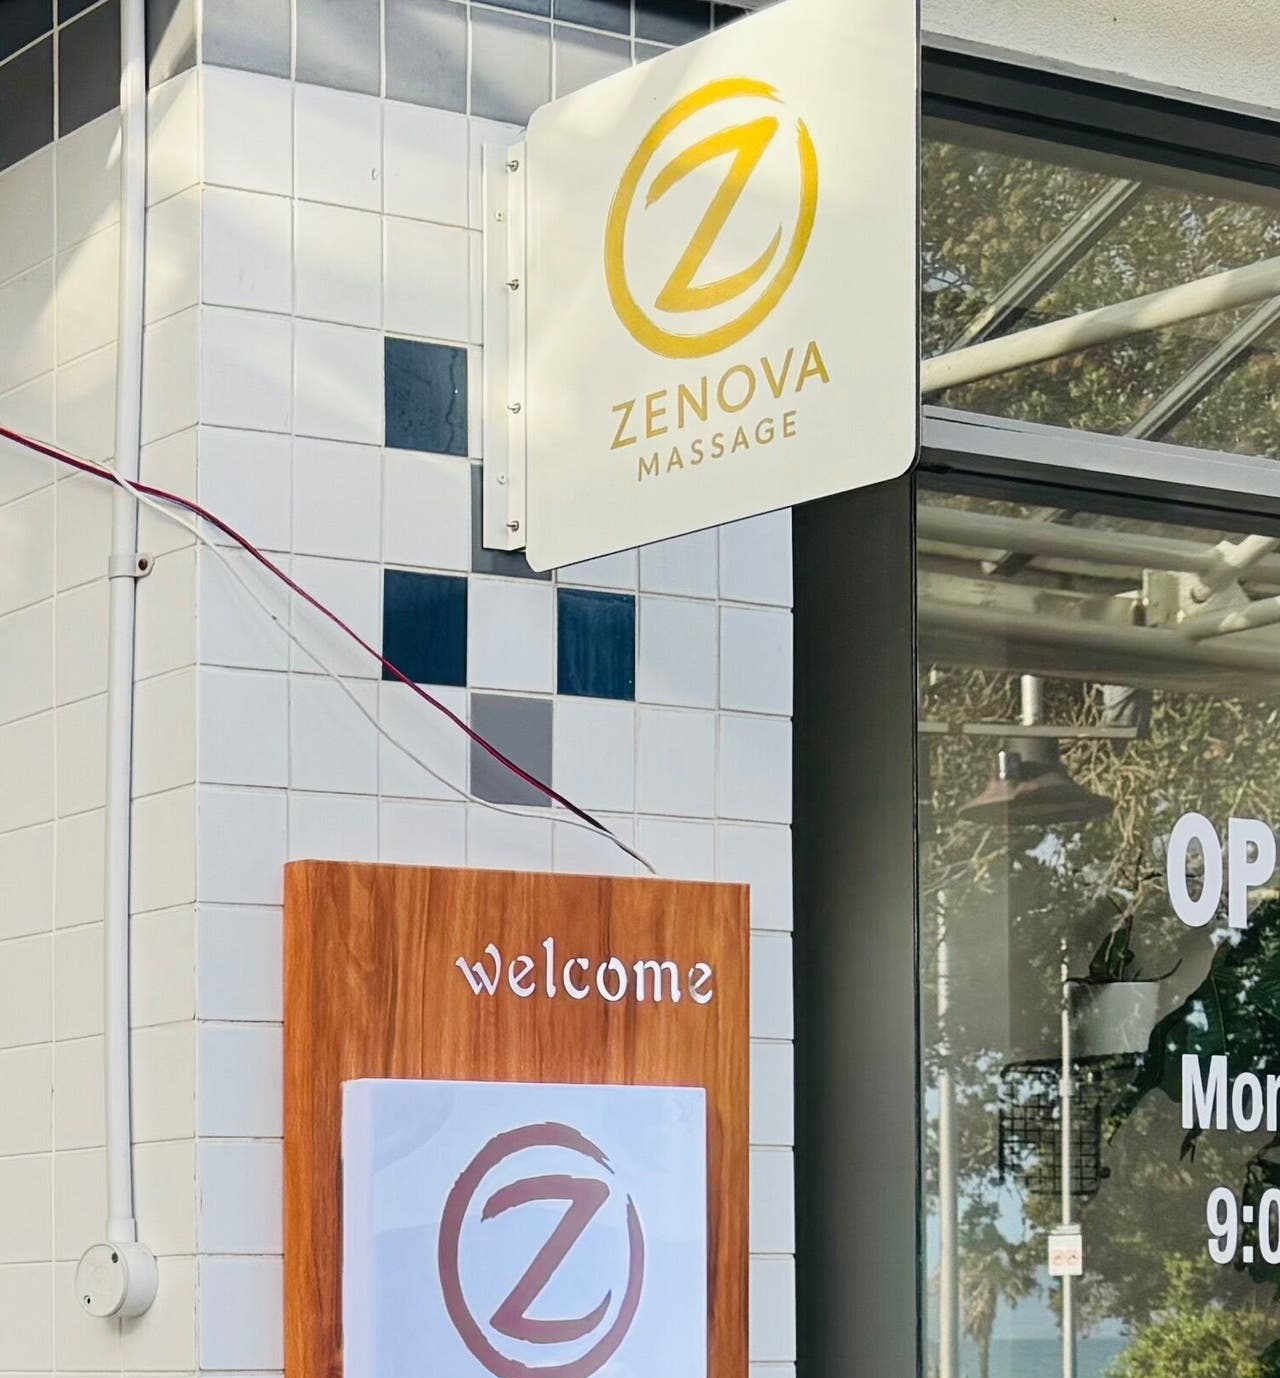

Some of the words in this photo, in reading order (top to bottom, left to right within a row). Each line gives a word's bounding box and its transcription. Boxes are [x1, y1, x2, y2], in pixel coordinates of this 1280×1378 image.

[610, 340, 830, 450] ZENOVA
[637, 410, 798, 482] MASSAGE
[1167, 811, 1277, 930] OP
[455, 937, 713, 1005] welcome
